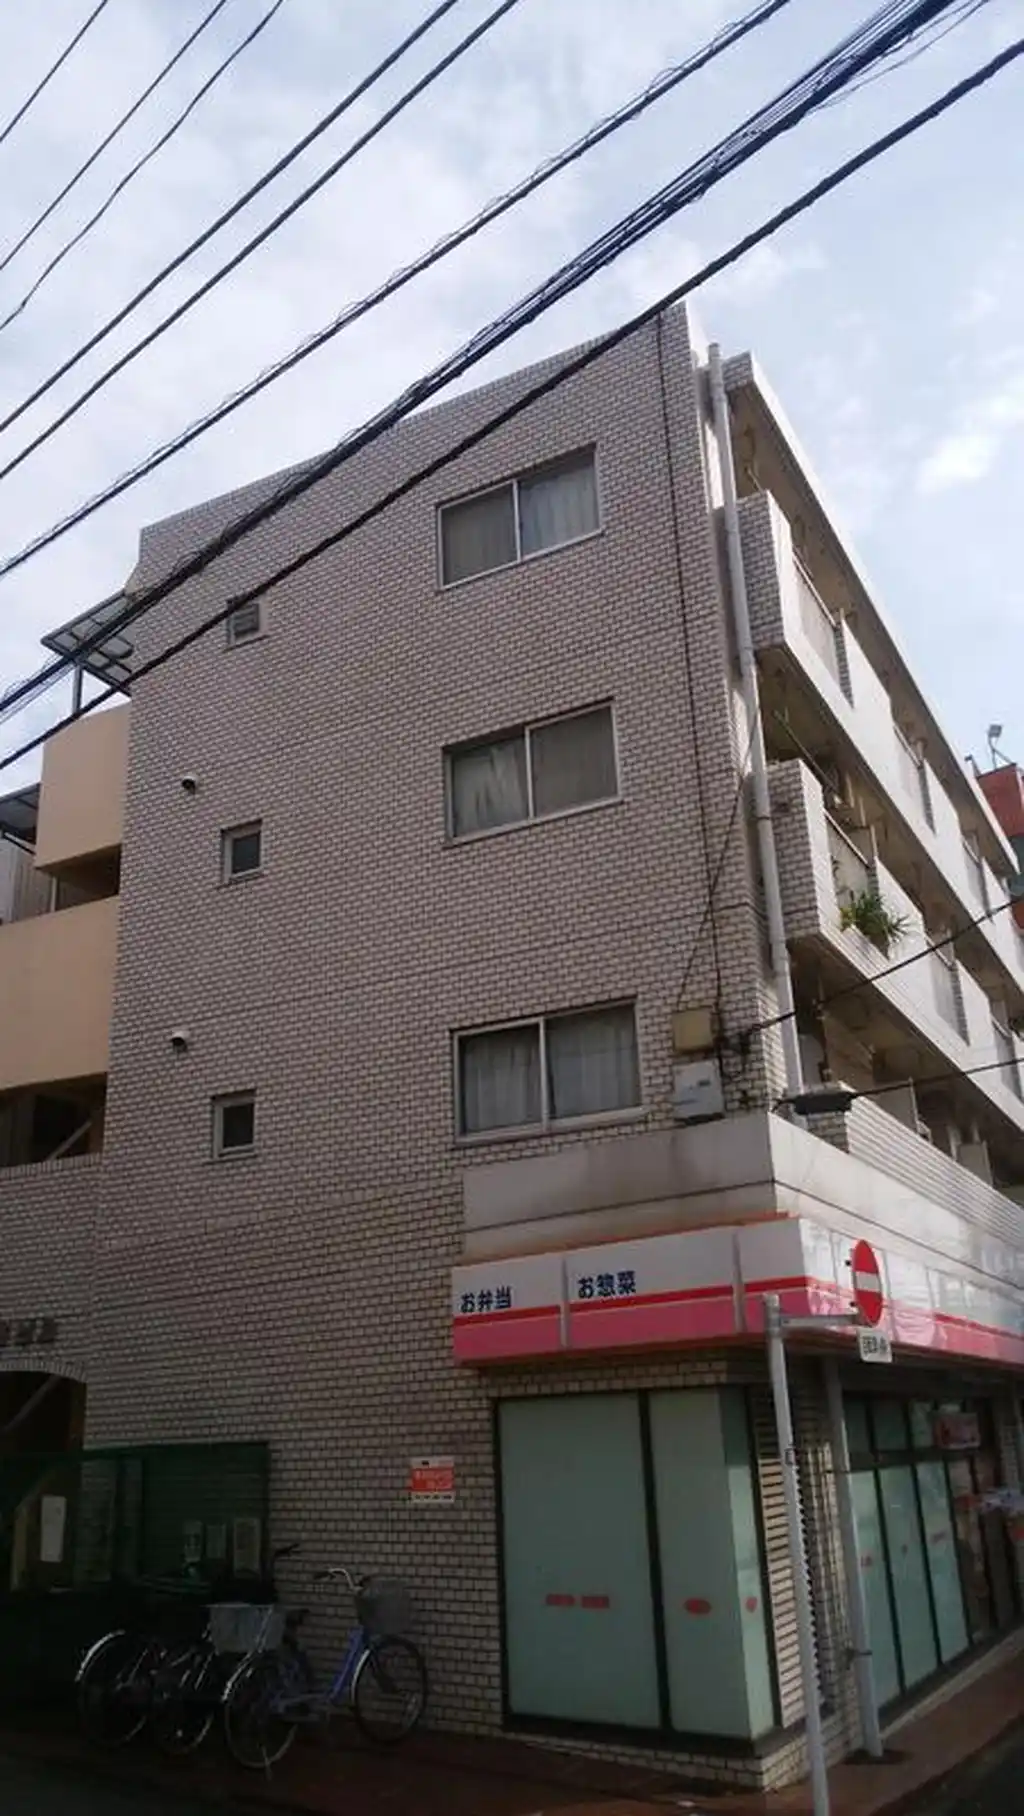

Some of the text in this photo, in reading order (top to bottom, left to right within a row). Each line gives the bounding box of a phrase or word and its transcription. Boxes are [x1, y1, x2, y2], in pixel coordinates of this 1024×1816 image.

[578, 1270, 636, 1298] お惣菜
[460, 1286, 511, 1313] お弁当
